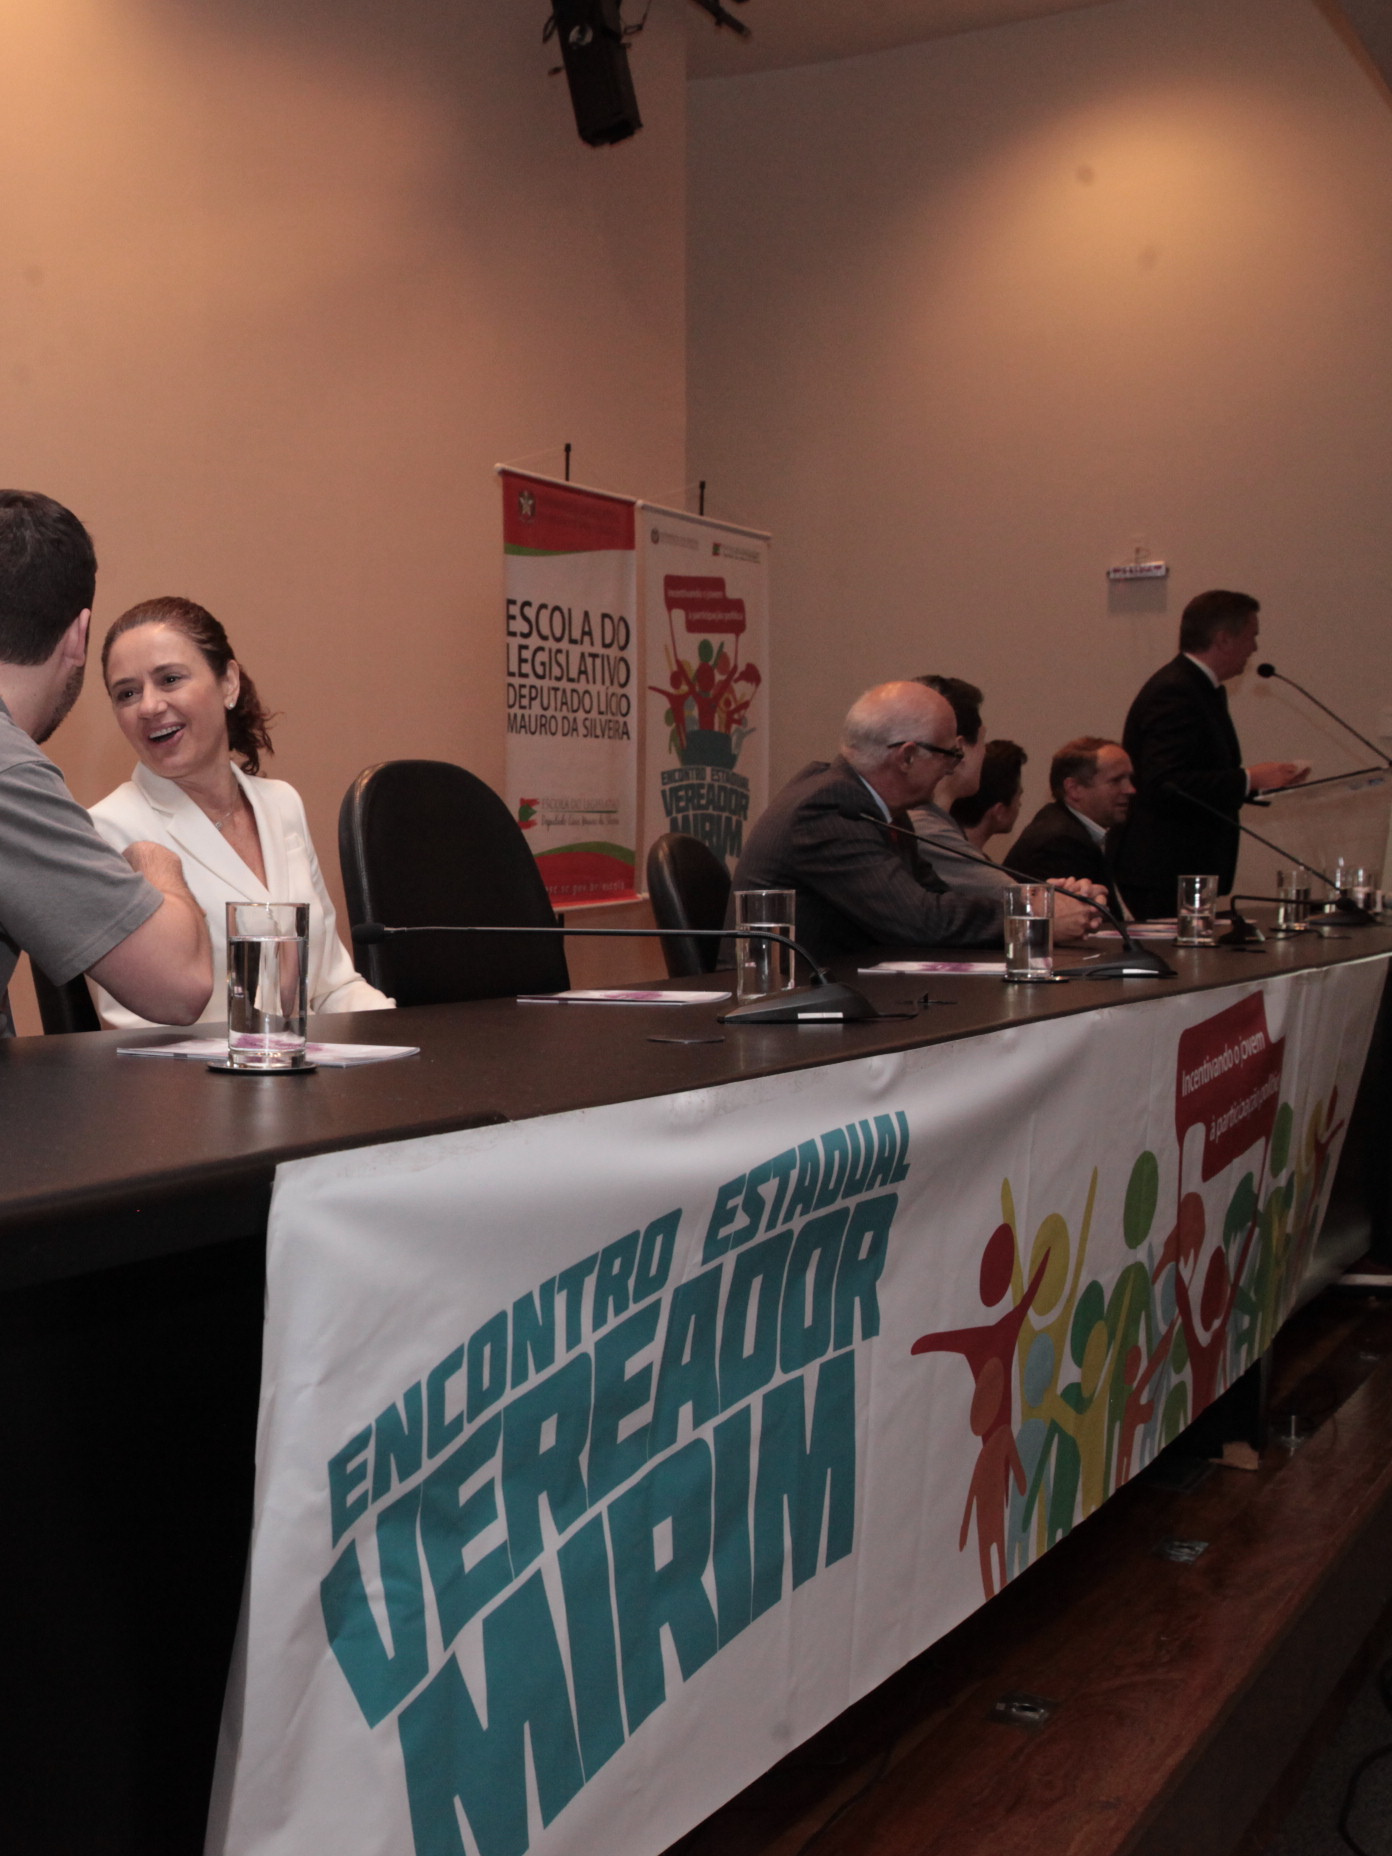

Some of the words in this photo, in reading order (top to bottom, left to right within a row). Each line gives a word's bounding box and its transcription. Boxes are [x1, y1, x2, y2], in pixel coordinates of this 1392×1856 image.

[506, 598, 594, 647] ESCOLA
[600, 612, 631, 652] DO
[506, 642, 631, 689] LEGISLATIVO
[506, 682, 594, 715] DEPUTADO
[507, 712, 559, 737] MAURO
[561, 715, 579, 738] DA
[660, 782, 750, 821] VEREADOR
[1181, 1043, 1233, 1098] Incentivando
[1239, 1031, 1266, 1068] jovem
[327, 1207, 683, 1550] ENCONTRO
[701, 1110, 911, 1265] ESTADUAL
[319, 1191, 899, 1730] VEREADOR
[397, 1349, 856, 1856] MIRIM
